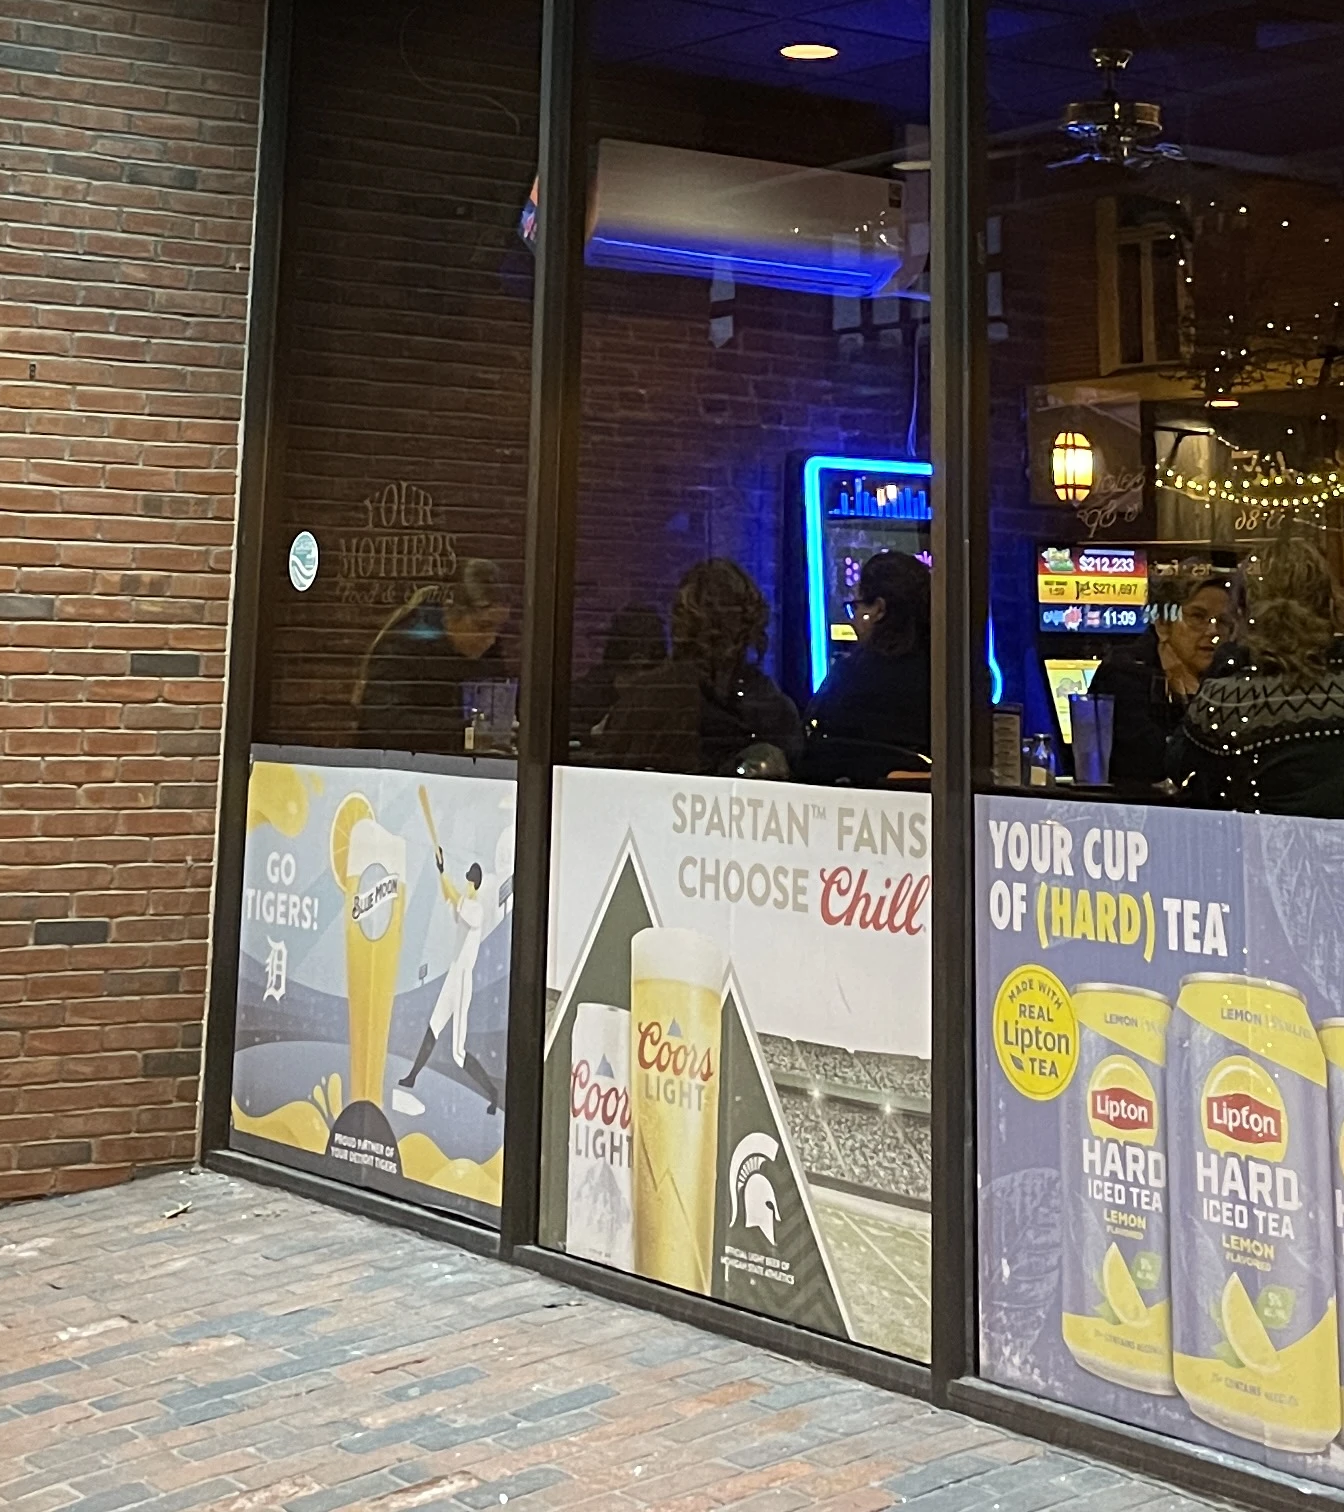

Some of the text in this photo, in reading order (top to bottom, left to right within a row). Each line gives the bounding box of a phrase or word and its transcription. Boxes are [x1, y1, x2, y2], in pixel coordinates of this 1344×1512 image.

[364, 481, 433, 529] YOUR
[339, 534, 456, 577] MOTHERS
[1079, 555, 1134, 573] $212,233
[1103, 610, 1136, 627] 11:09
[837, 807, 928, 859] FANS
[988, 820, 1149, 882] YOUR CUP
[267, 851, 296, 886] GO
[678, 855, 810, 913] CHOOSE
[375, 879, 397, 903] MOON
[245, 888, 319, 931] TIGERS!
[989, 880, 1028, 932] OF
[1037, 881, 1156, 963] (HARD)
[1008, 978, 1062, 1010] MADE WITH
[1018, 1003, 1054, 1023] REAL
[1104, 1013, 1138, 1028] LEMON
[1220, 1008, 1262, 1026] LEMON
[637, 1021, 714, 1082] Coors
[1003, 1020, 1070, 1056] Lipton
[1028, 1057, 1059, 1079] TEA
[644, 1073, 706, 1111] LIGHT
[1096, 1094, 1148, 1123] Lipton
[1212, 1101, 1278, 1137] Lipton
[1082, 1138, 1166, 1188] HARD
[1196, 1151, 1300, 1211] HARD
[1088, 1177, 1163, 1213] ICED TEA
[1103, 1208, 1147, 1230] LEMON
[1202, 1198, 1295, 1240] ICED TEA
[1222, 1233, 1275, 1261] LEMON
